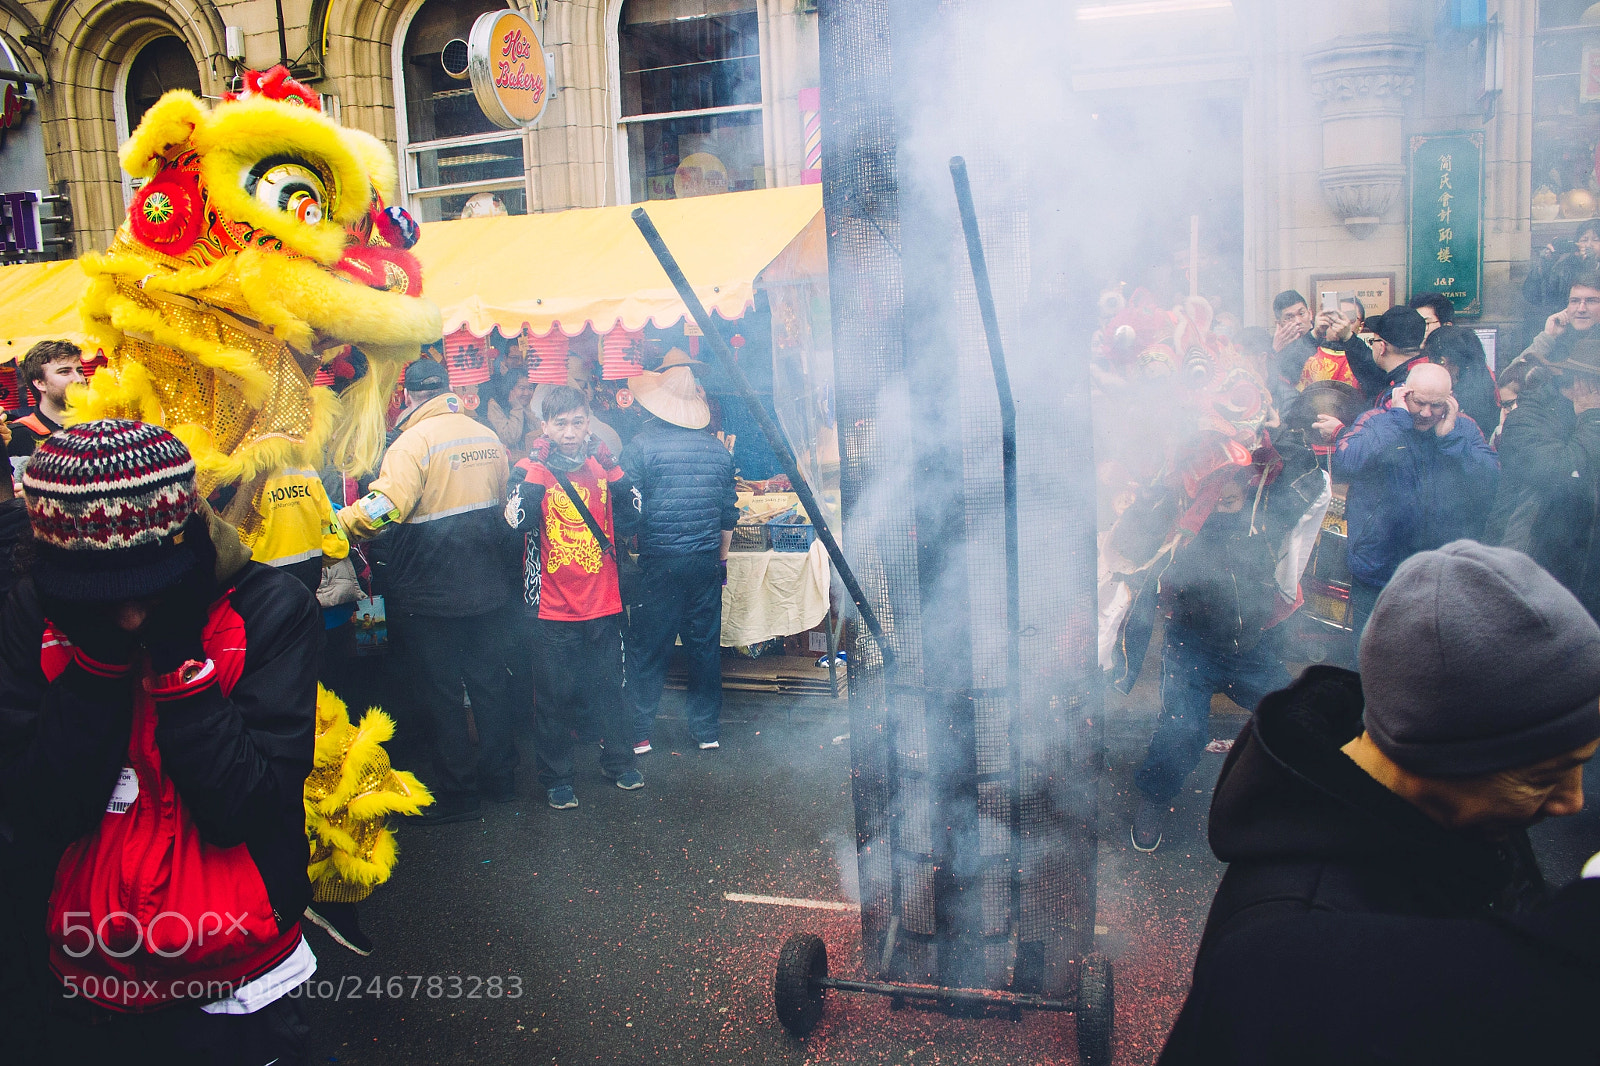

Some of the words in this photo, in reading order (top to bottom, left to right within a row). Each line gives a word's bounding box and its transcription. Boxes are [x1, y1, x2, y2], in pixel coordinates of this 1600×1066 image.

[503, 29, 531, 63] Ho's
[496, 60, 545, 103] Bakery
[1433, 277, 1455, 286] J&P
[460, 448, 500, 463] SHOWSEC
